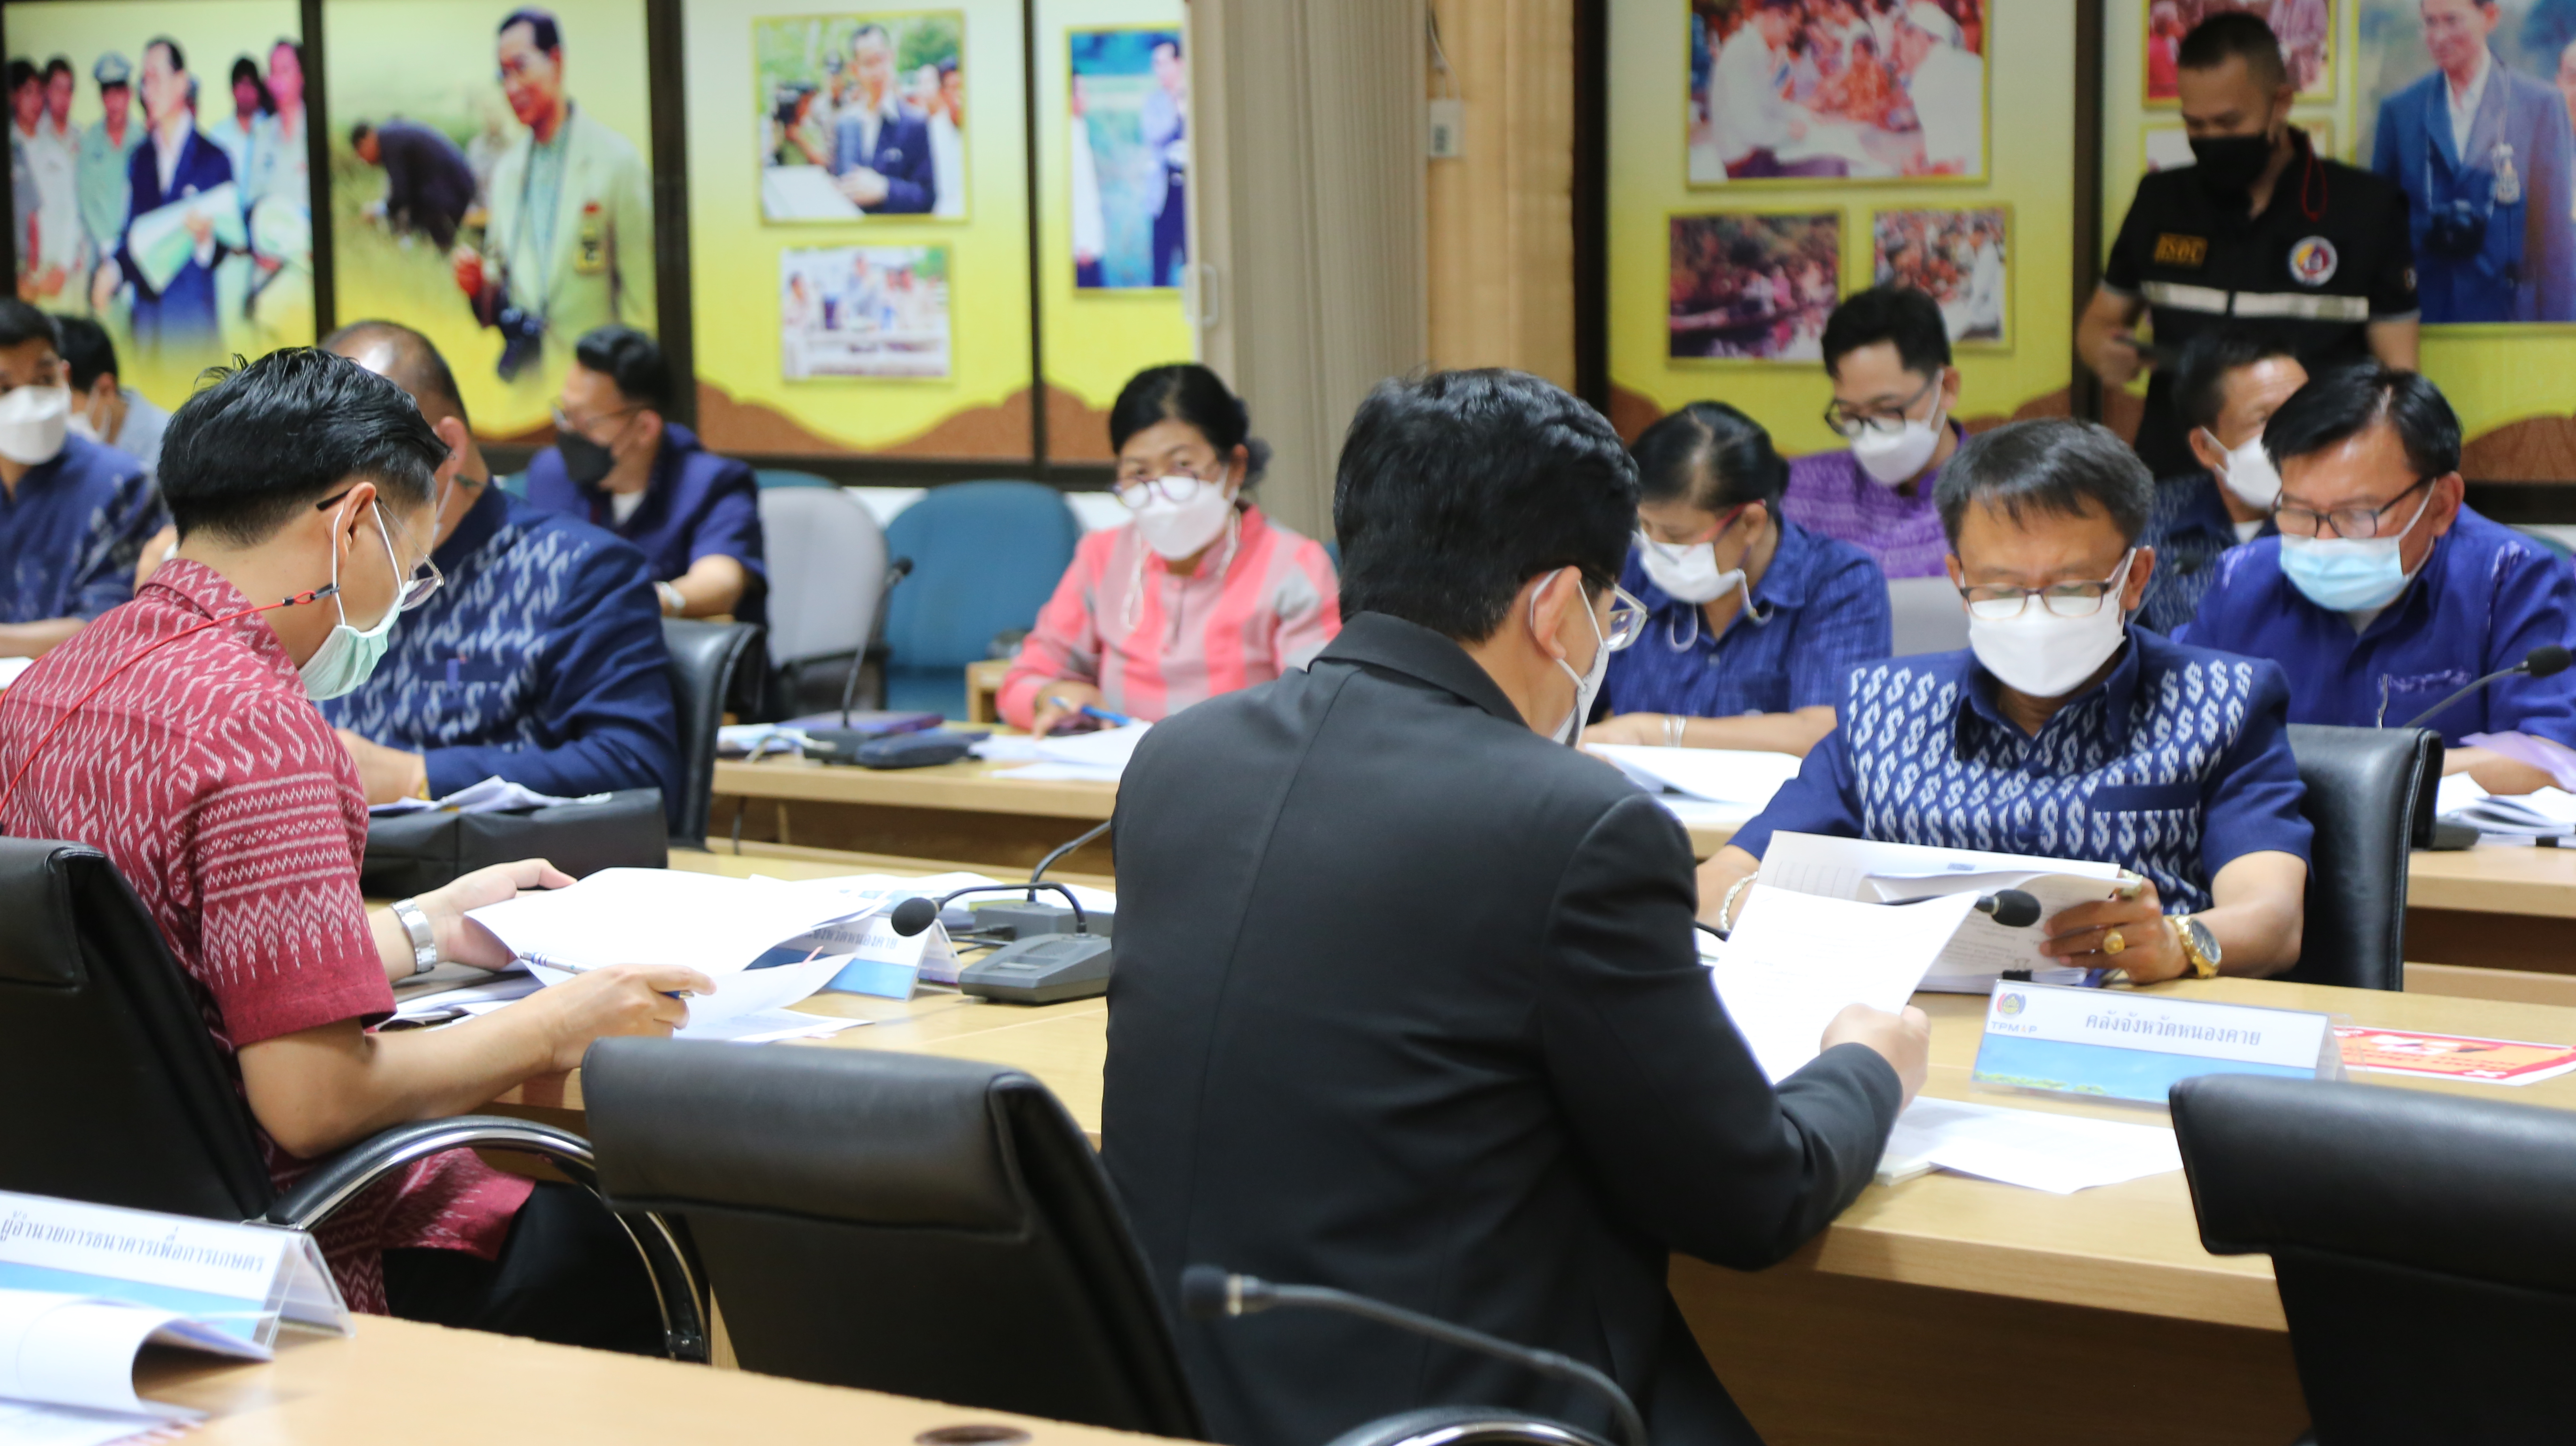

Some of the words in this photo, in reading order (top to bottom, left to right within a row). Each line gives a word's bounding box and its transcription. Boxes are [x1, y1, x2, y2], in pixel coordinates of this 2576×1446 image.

[1991, 1020, 2037, 1034] TPMAP
[2085, 1009, 2262, 1046] คลังจังหวัดหนองคาย
